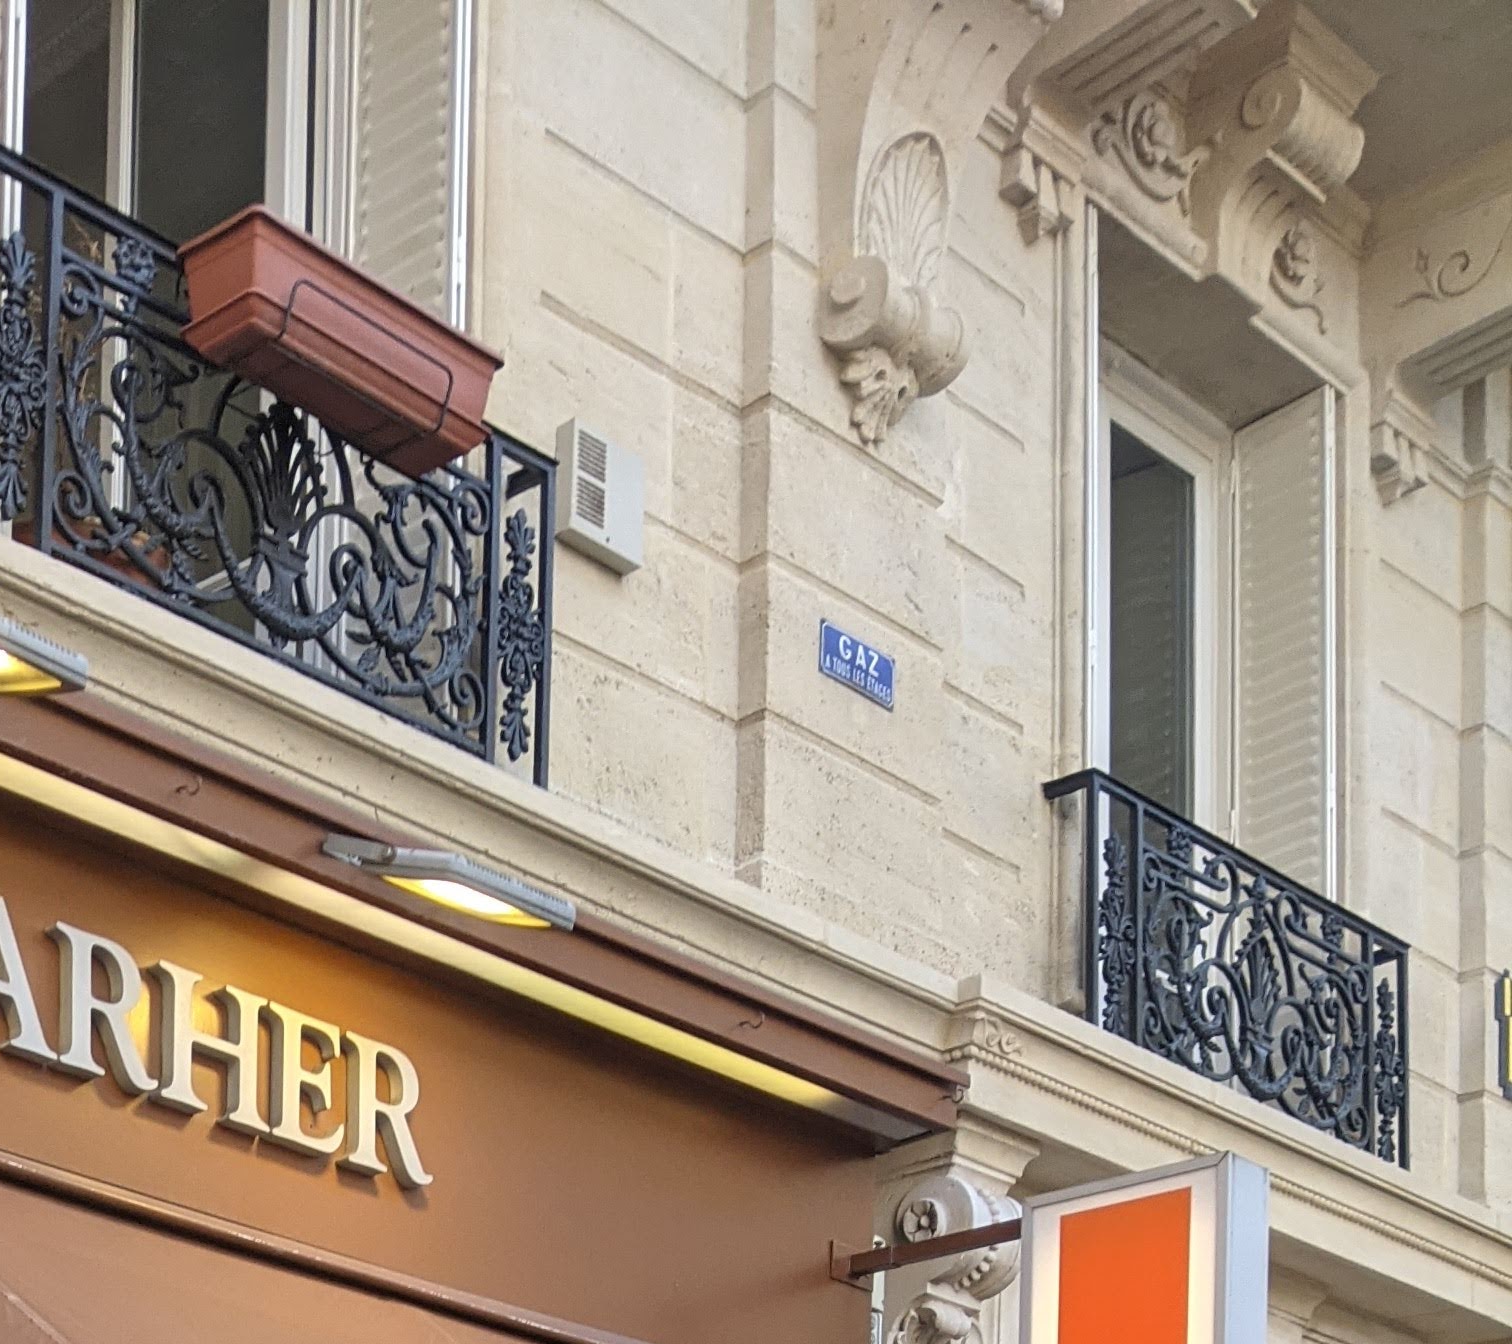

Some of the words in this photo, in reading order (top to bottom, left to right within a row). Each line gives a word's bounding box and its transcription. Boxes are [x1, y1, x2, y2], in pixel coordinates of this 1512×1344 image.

[832, 656, 851, 679] TOUS
[852, 667, 865, 687] LES
[839, 634, 880, 678] GAZ
